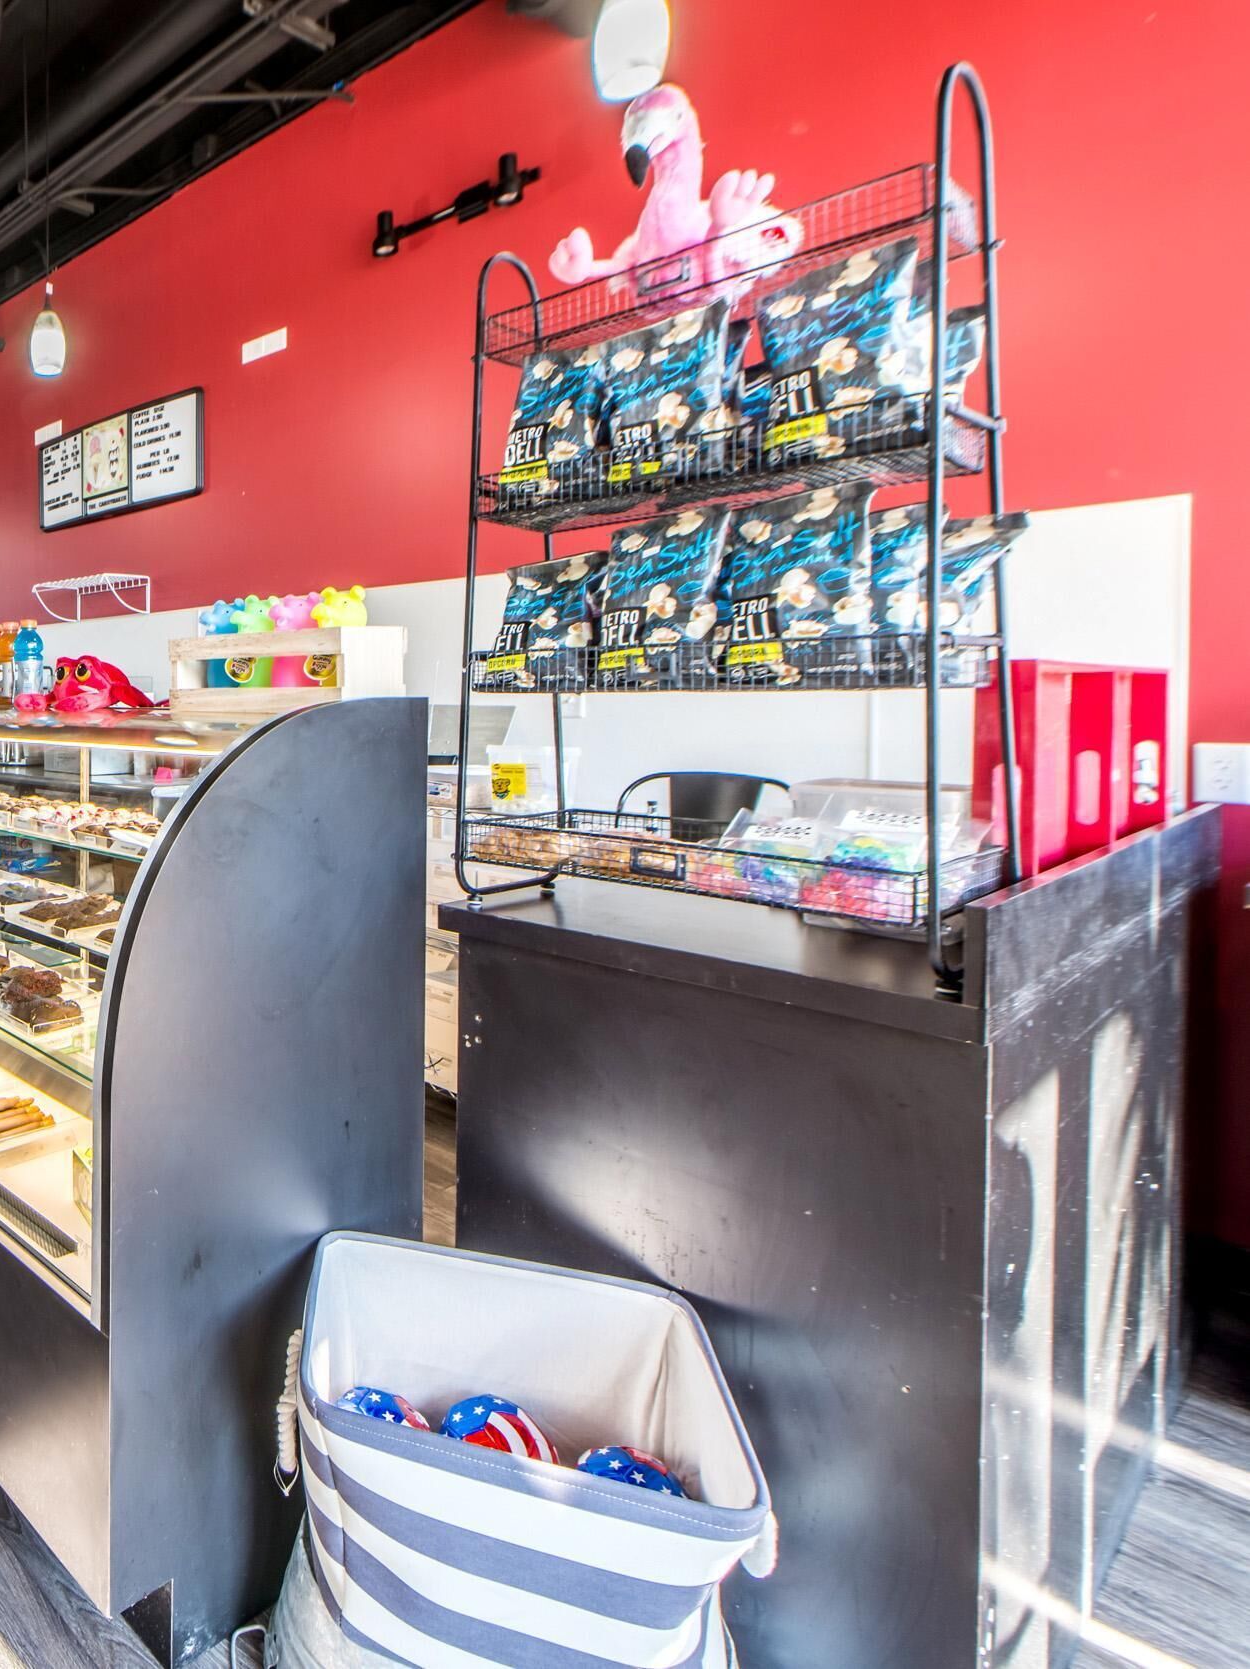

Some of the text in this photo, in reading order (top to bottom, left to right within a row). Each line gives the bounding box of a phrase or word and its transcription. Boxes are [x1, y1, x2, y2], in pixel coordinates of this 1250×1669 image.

[773, 371, 812, 399] ETRO
[613, 423, 652, 446] ETRO
[790, 511, 862, 556] Salt
[656, 528, 718, 571] Salt
[732, 597, 768, 618] ETRO
